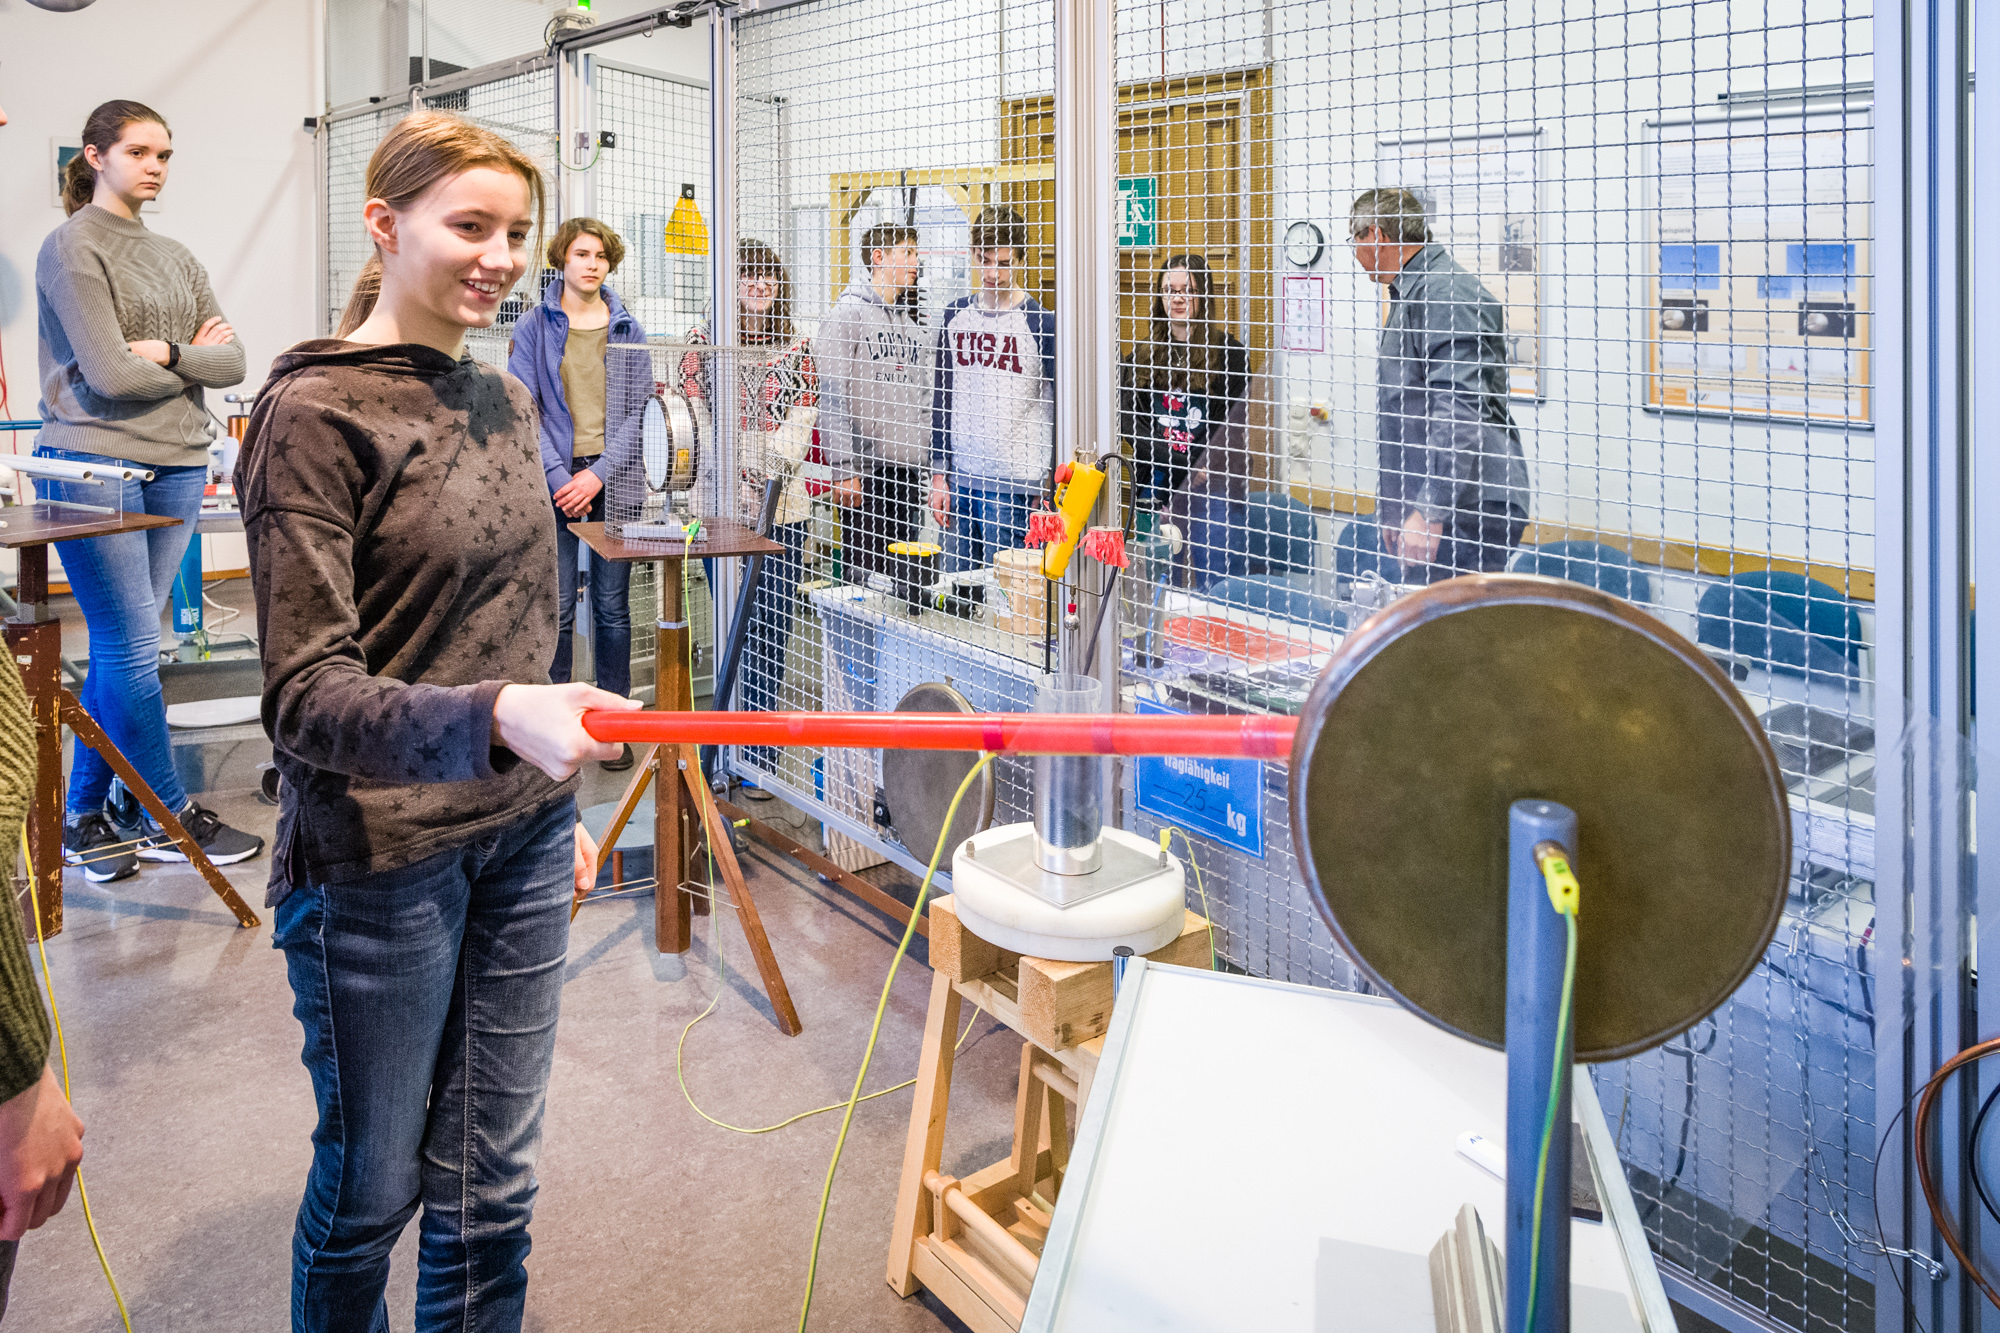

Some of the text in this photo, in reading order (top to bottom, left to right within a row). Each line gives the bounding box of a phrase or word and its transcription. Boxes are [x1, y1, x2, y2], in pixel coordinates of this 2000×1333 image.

[866, 332, 922, 365] LONDON
[953, 332, 1022, 374] USA
[1226, 802, 1246, 837] kg
